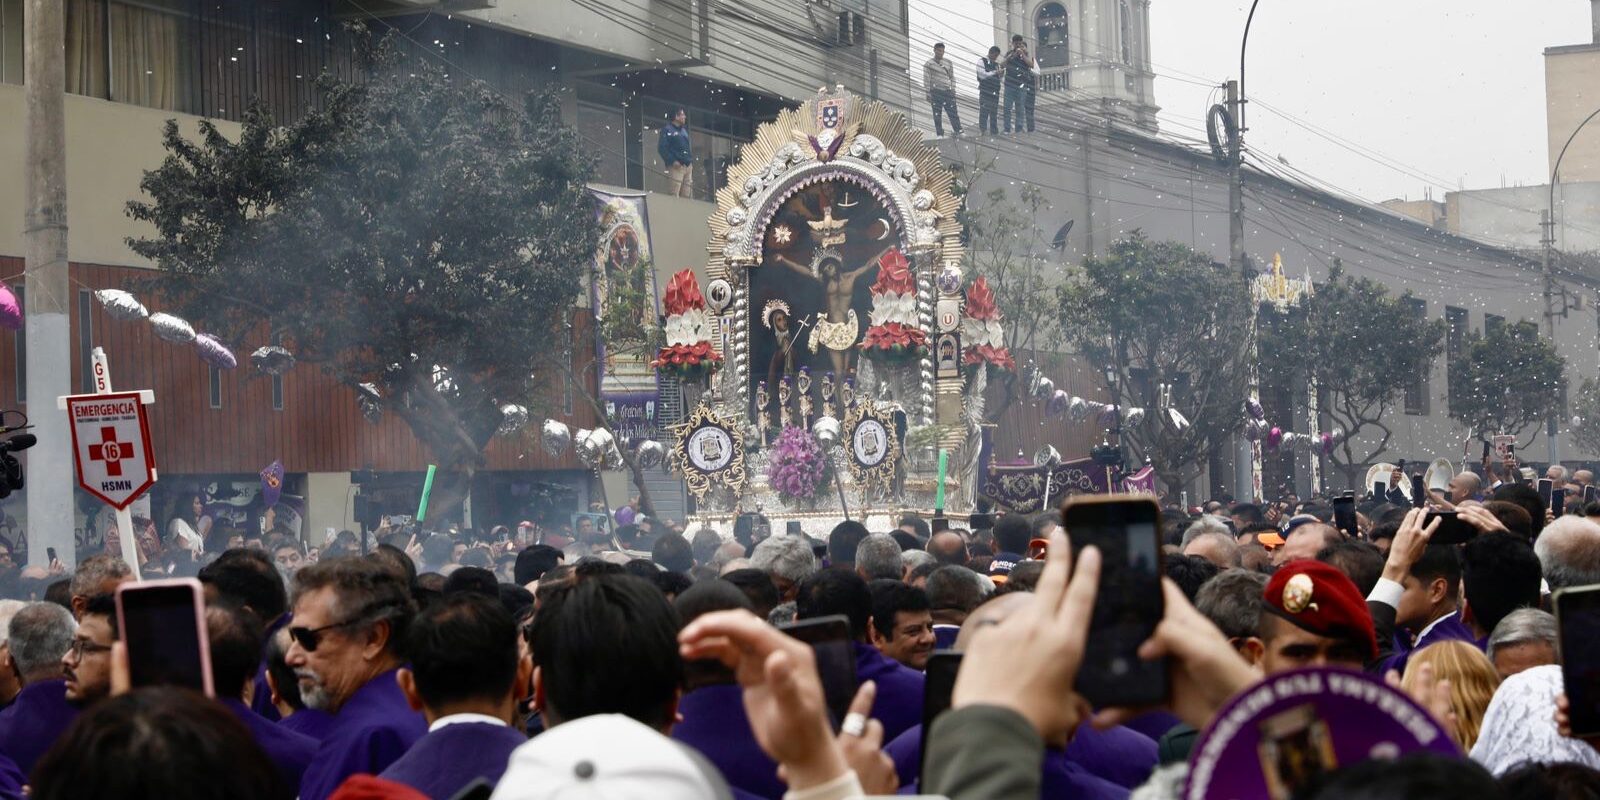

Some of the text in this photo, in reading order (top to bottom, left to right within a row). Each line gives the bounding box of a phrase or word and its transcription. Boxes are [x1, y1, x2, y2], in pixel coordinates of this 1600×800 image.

[95, 362, 103, 376] G
[97, 377, 105, 390] 5
[75, 403, 135, 417] EMERGENCIA
[104, 444, 118, 459] 16
[101, 480, 132, 491] HSMN
